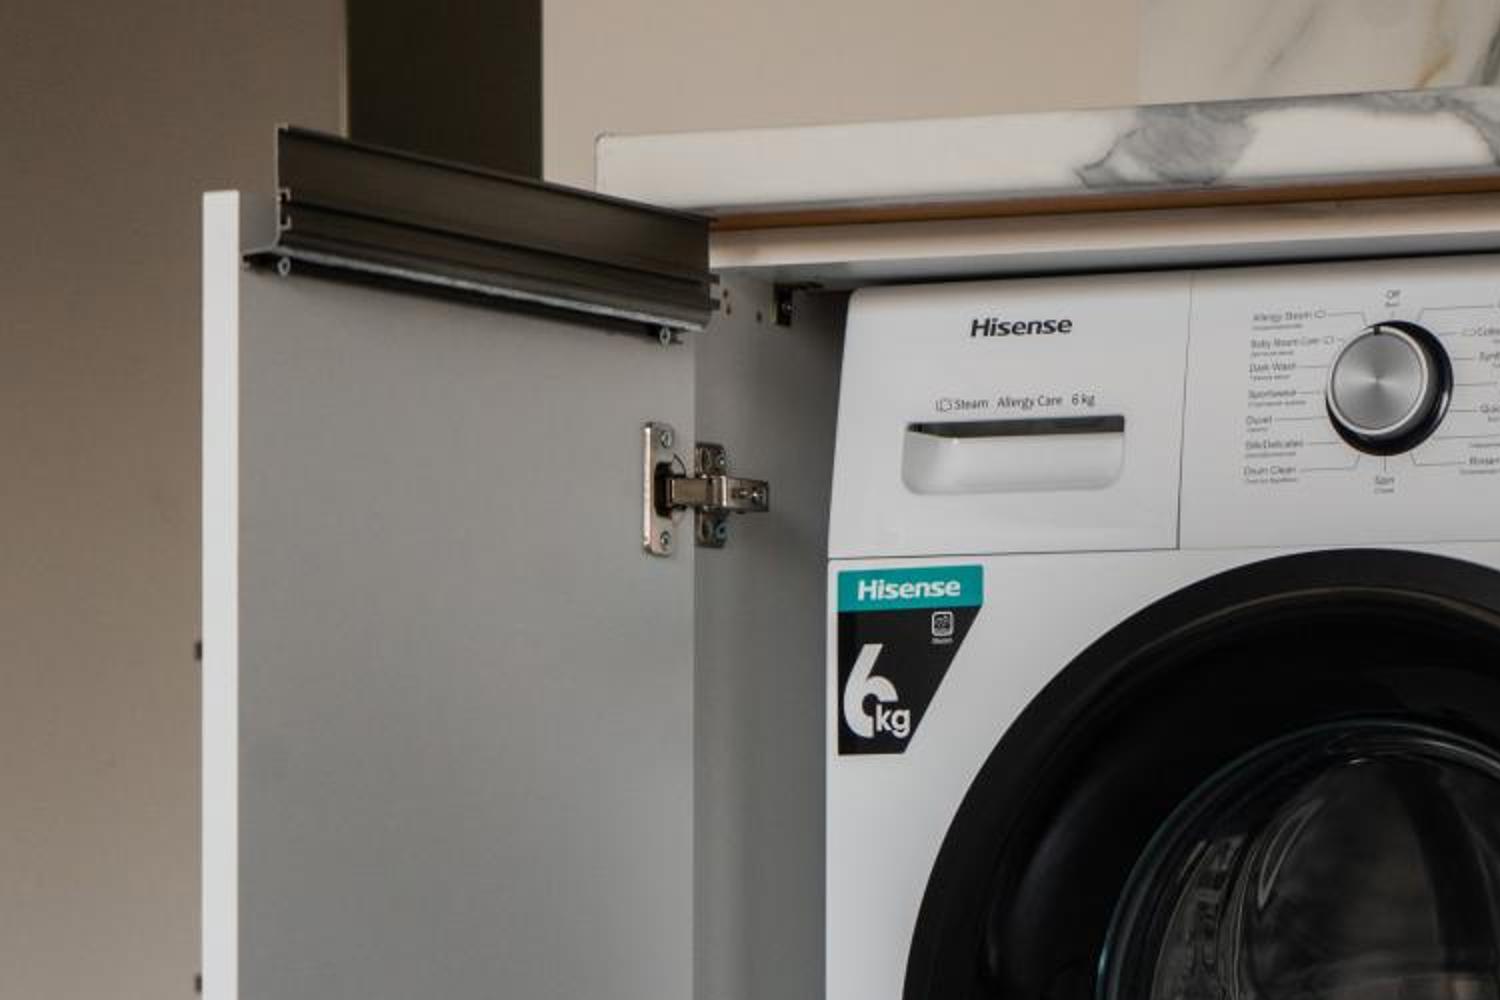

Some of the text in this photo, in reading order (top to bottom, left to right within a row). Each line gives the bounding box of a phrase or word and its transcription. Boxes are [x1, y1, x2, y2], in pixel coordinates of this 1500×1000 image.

[970, 317, 1073, 338] Hisense
[857, 579, 961, 600] Hisense
[843, 643, 911, 738] 6 kg
